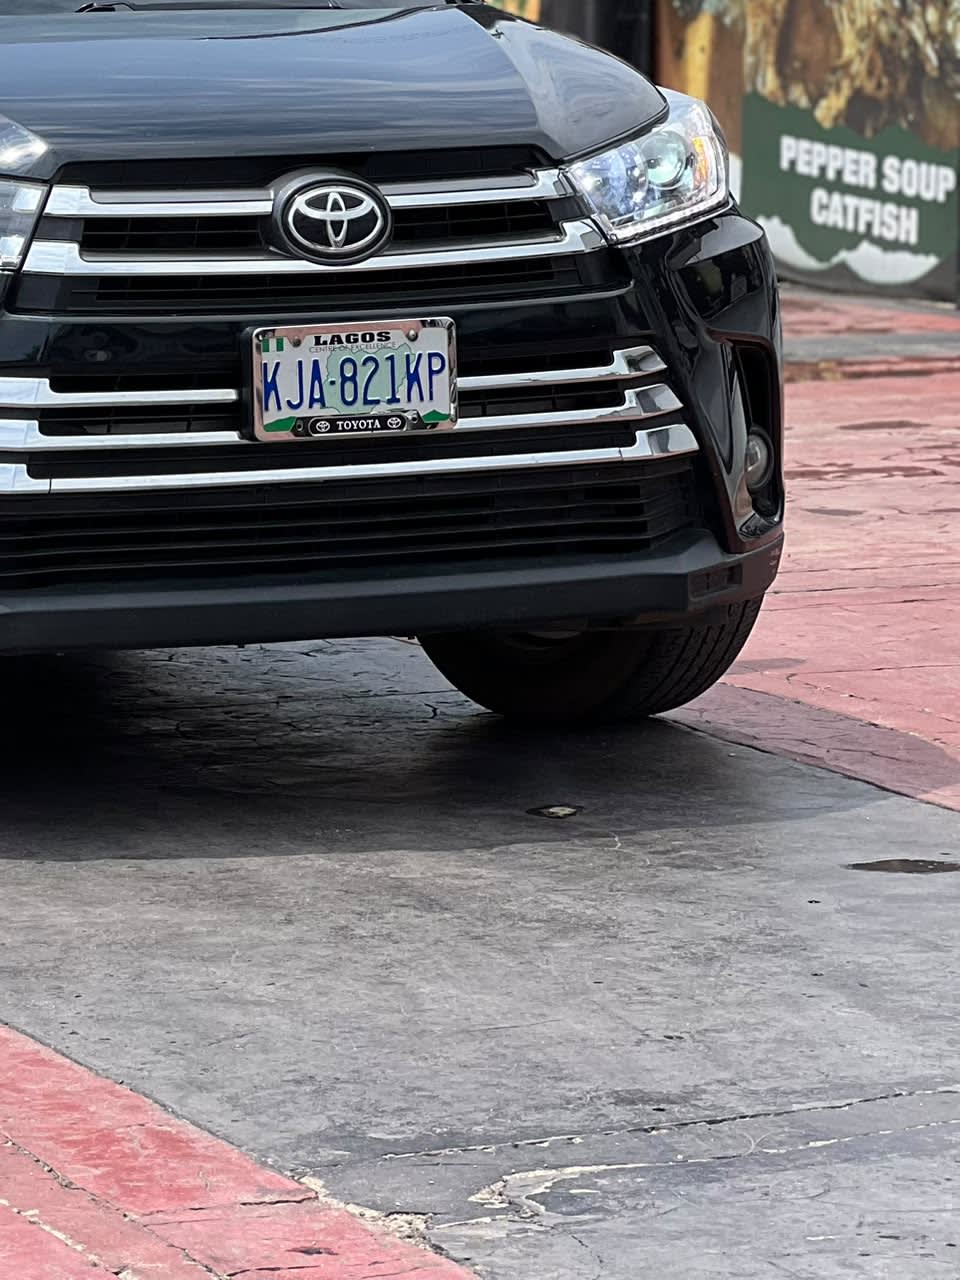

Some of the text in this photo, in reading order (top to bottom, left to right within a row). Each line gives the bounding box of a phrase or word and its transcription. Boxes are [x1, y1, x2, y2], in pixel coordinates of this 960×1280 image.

[780, 135, 956, 203] PEPPER SOUP
[810, 187, 919, 245] CATFISH
[314, 331, 391, 346] LAGOS
[262, 352, 446, 411] KJA-821KP
[337, 420, 381, 430] TOYOTA
